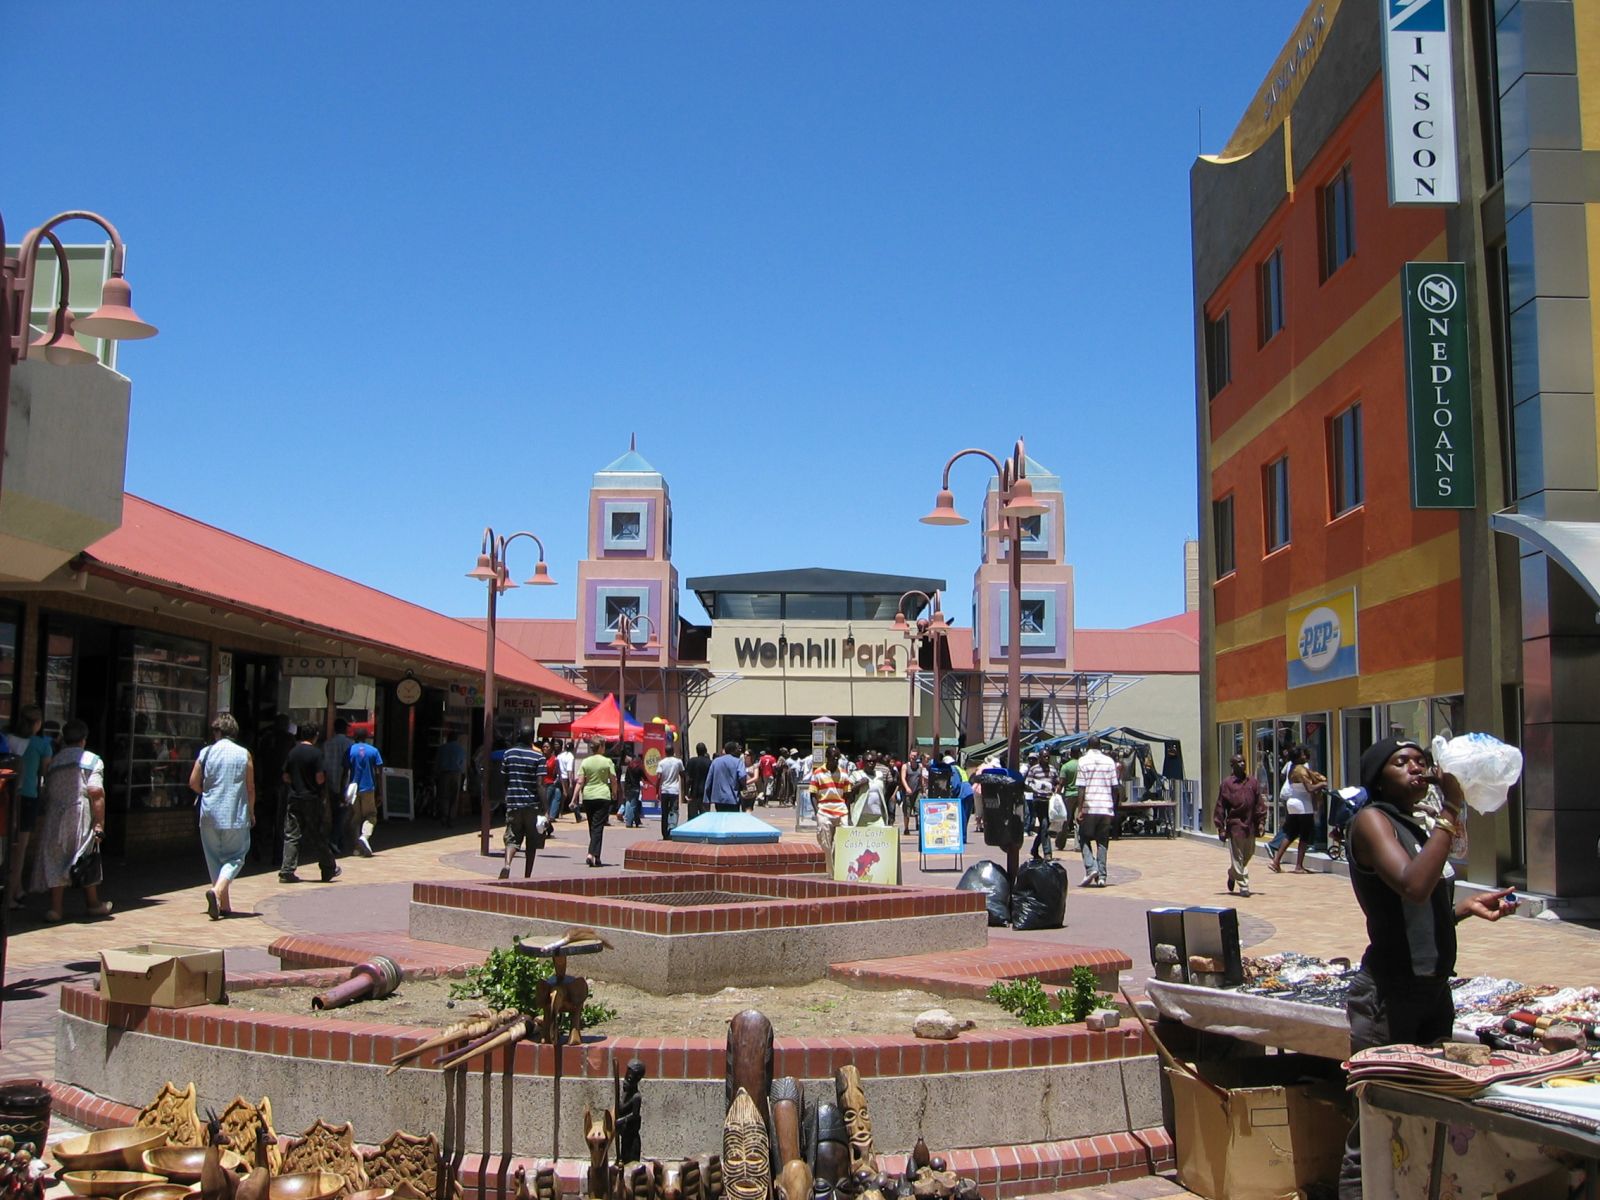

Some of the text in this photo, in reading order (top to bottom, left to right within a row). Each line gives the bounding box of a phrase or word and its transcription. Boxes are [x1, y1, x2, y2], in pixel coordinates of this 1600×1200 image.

[1409, 37, 1437, 197] INSCON
[1428, 318, 1455, 497] NEDLOANS
[1302, 621, 1332, 656] PEP
[287, 658, 350, 669] ZOOTY
[844, 839, 889, 849] Cash Loans
[864, 828, 882, 838] Cash
